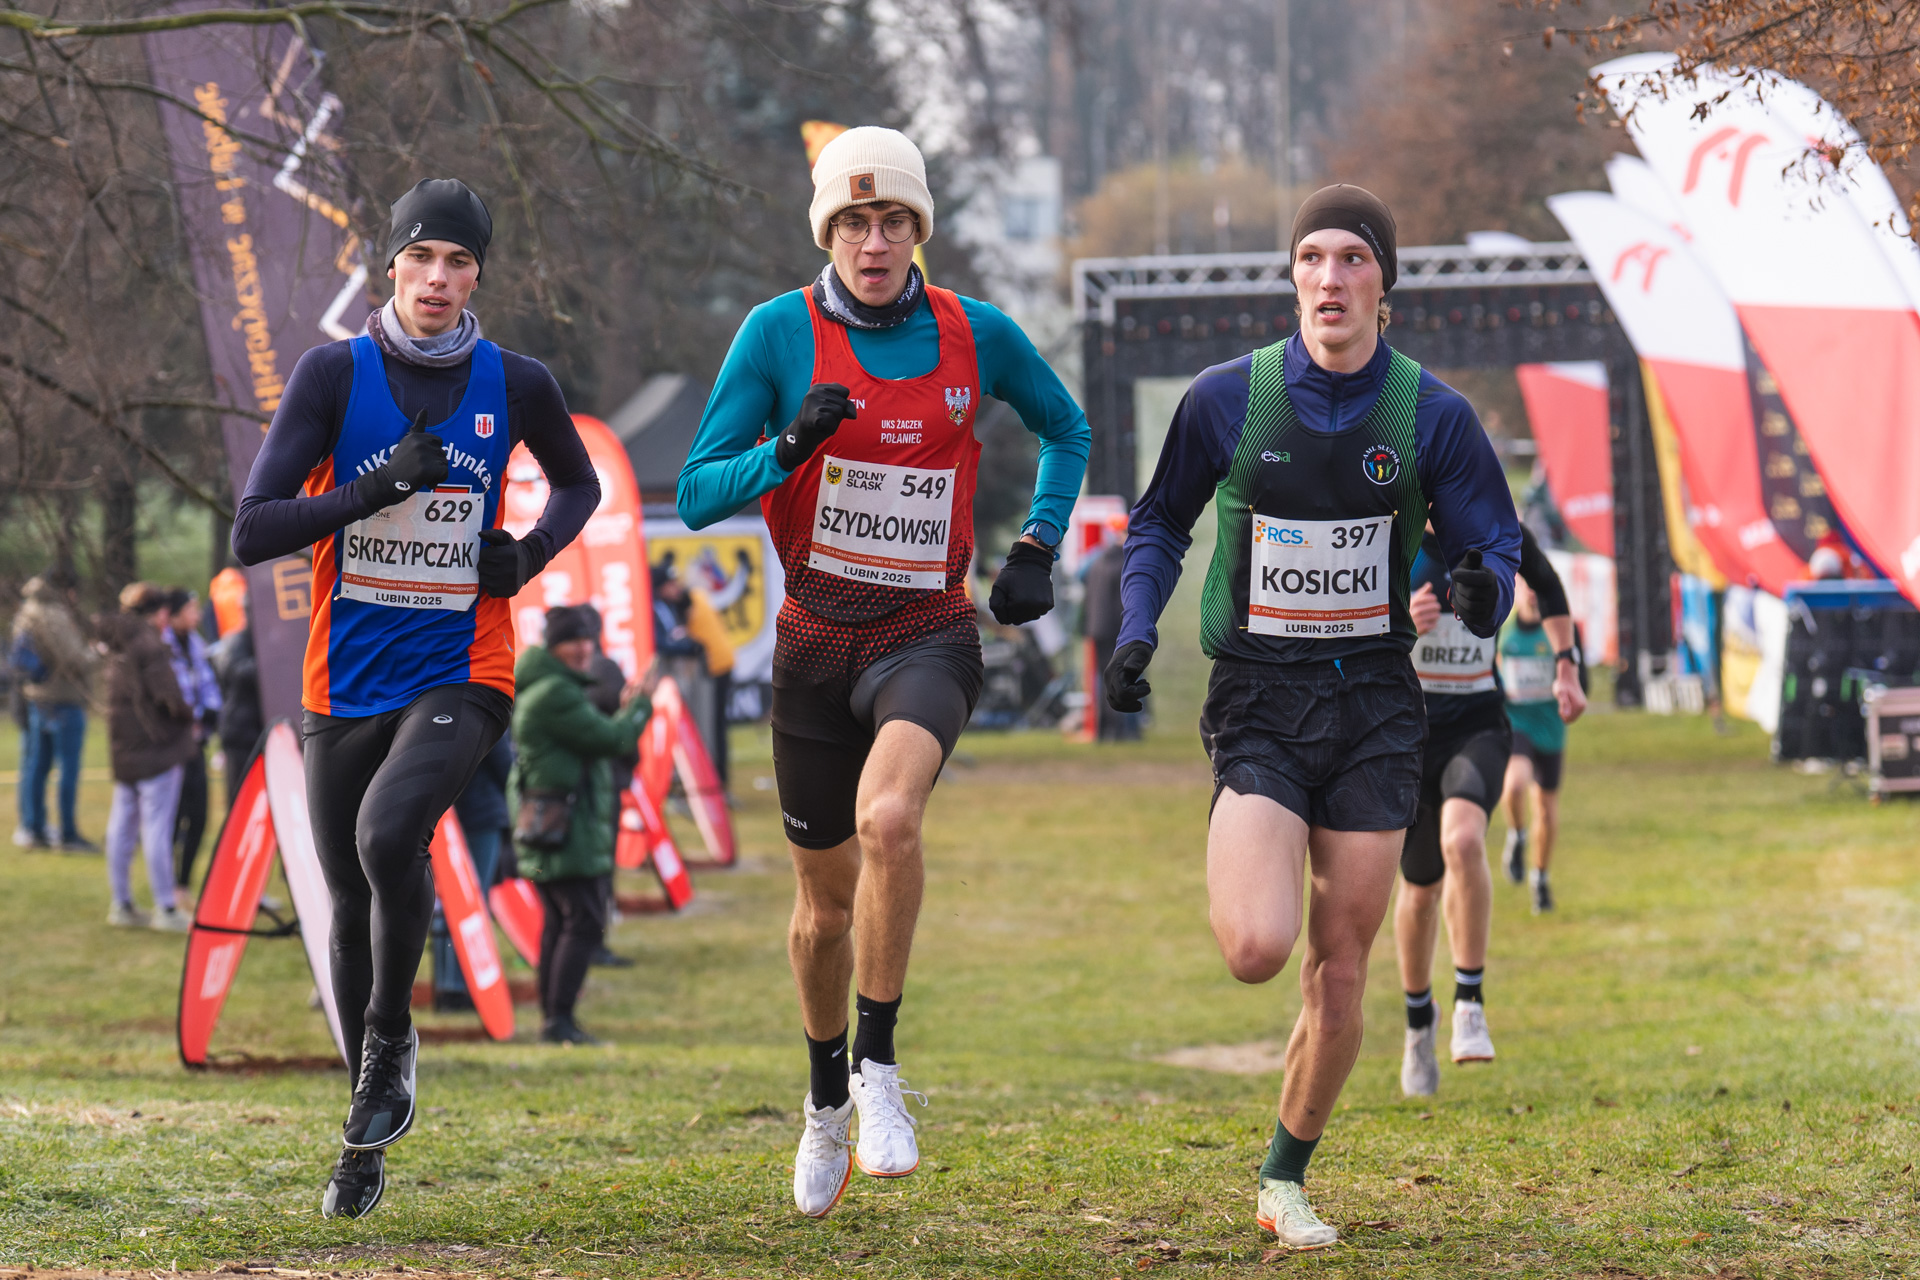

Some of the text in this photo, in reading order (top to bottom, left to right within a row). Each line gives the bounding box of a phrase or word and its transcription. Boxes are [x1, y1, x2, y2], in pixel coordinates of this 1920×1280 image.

[881, 418, 923, 429] UKS ŻACZEK
[880, 433, 922, 444] POŁANIEC
[1261, 450, 1291, 463] esa
[1362, 444, 1400, 465] AML SŁUPSK
[846, 477, 883, 492] ŚLĄSK
[848, 469, 947, 500] DOLNY 549
[424, 500, 473, 523] 629
[819, 505, 947, 545] SZYDŁOWSKI
[1331, 522, 1379, 550] 397
[348, 534, 474, 568] SKRZYPCZAK
[836, 550, 867, 562] Mistrzostwa
[890, 561, 912, 569] Biegach
[366, 578, 397, 588] Mistrzostwa
[844, 566, 912, 584] LUBIN 2025
[1262, 565, 1378, 595] KOSICKI
[375, 592, 442, 605] LUBIN 2025
[1274, 610, 1308, 618] Mistrzostwa
[1330, 611, 1353, 619] Biegach
[1286, 624, 1354, 634] LUBIN 2025
[1422, 646, 1483, 664] BREZA
